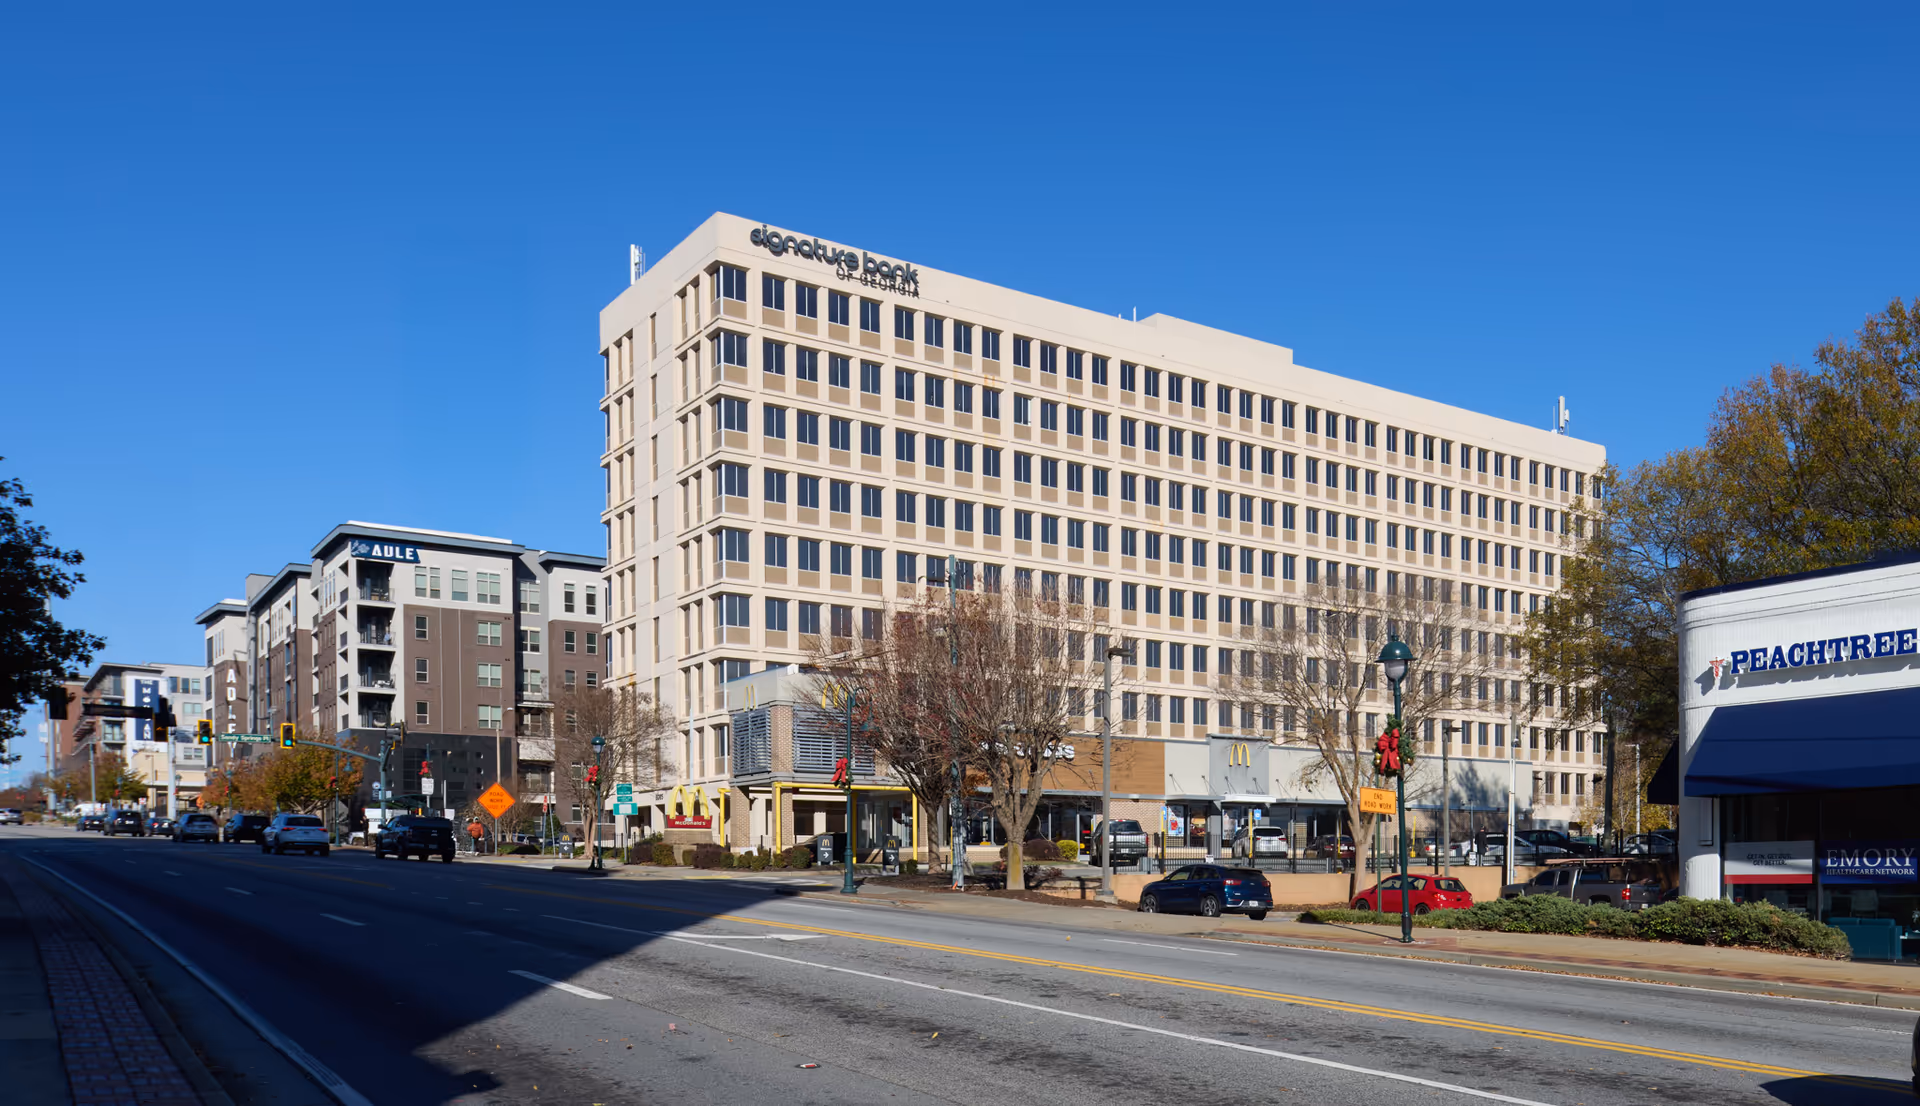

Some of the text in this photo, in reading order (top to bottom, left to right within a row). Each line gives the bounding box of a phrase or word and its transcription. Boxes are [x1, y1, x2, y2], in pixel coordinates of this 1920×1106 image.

[750, 224, 919, 286] signature bank
[836, 266, 920, 299] OF GEORGIA
[372, 544, 414, 560] AULE
[1730, 628, 1918, 675] PEACHTREE
[1364, 800, 1392, 810] ROAD WORK
[1373, 792, 1384, 801] END
[1826, 848, 1915, 868] EMORY
[1826, 868, 1915, 876] HEALTHCARE NETWORK
